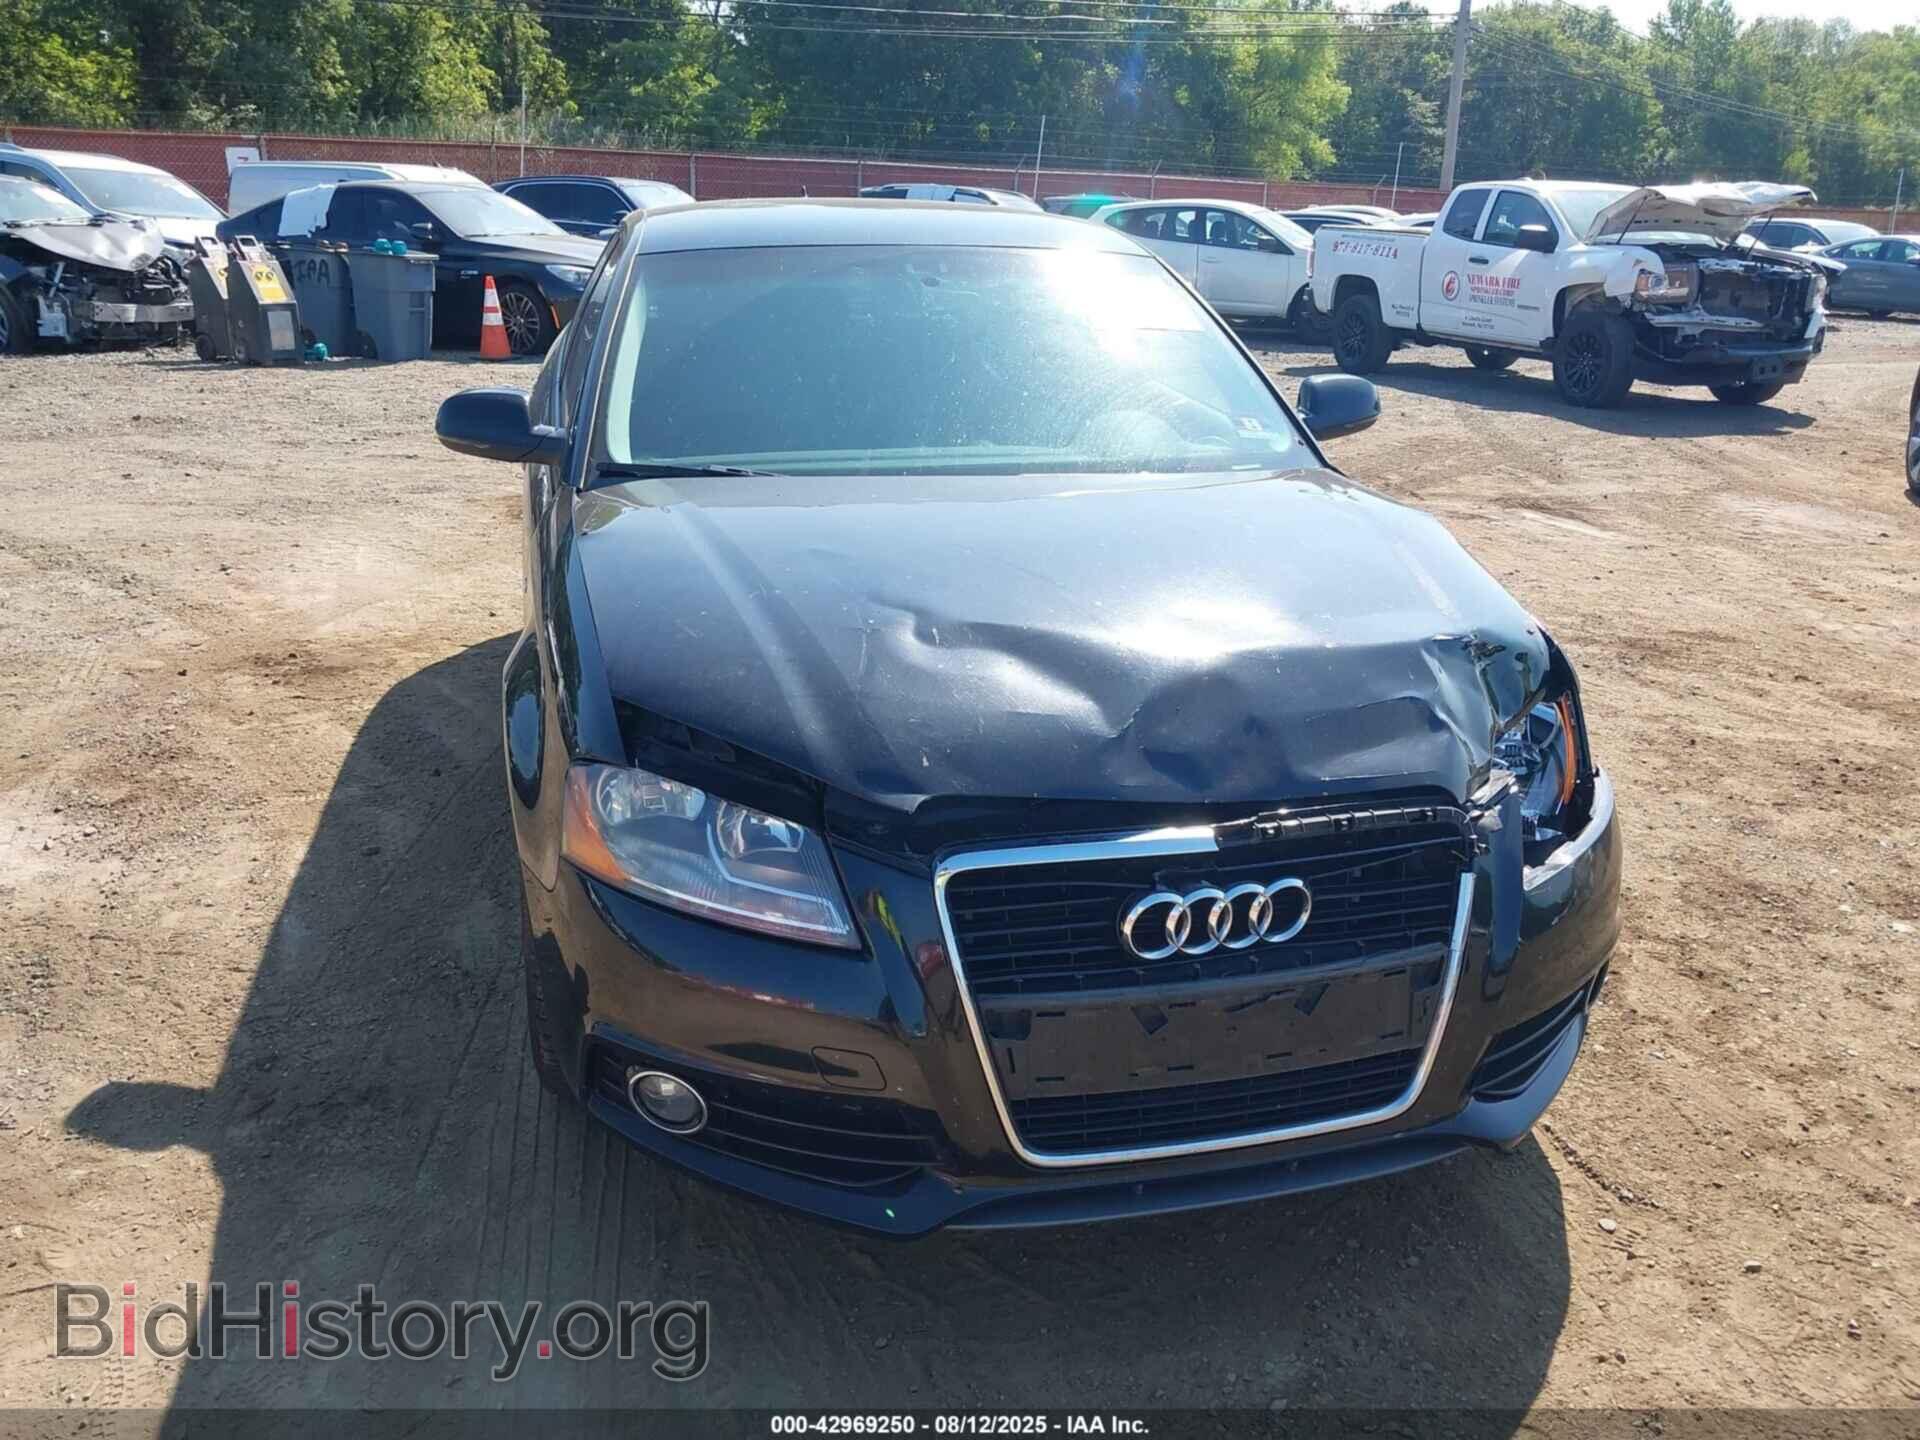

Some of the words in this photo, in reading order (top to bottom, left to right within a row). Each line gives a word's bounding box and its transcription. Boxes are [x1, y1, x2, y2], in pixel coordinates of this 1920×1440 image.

[1332, 240, 1399, 259] 973-817-8114
[1467, 272, 1500, 289] NEWARK
[1502, 276, 1521, 290] FIRE
